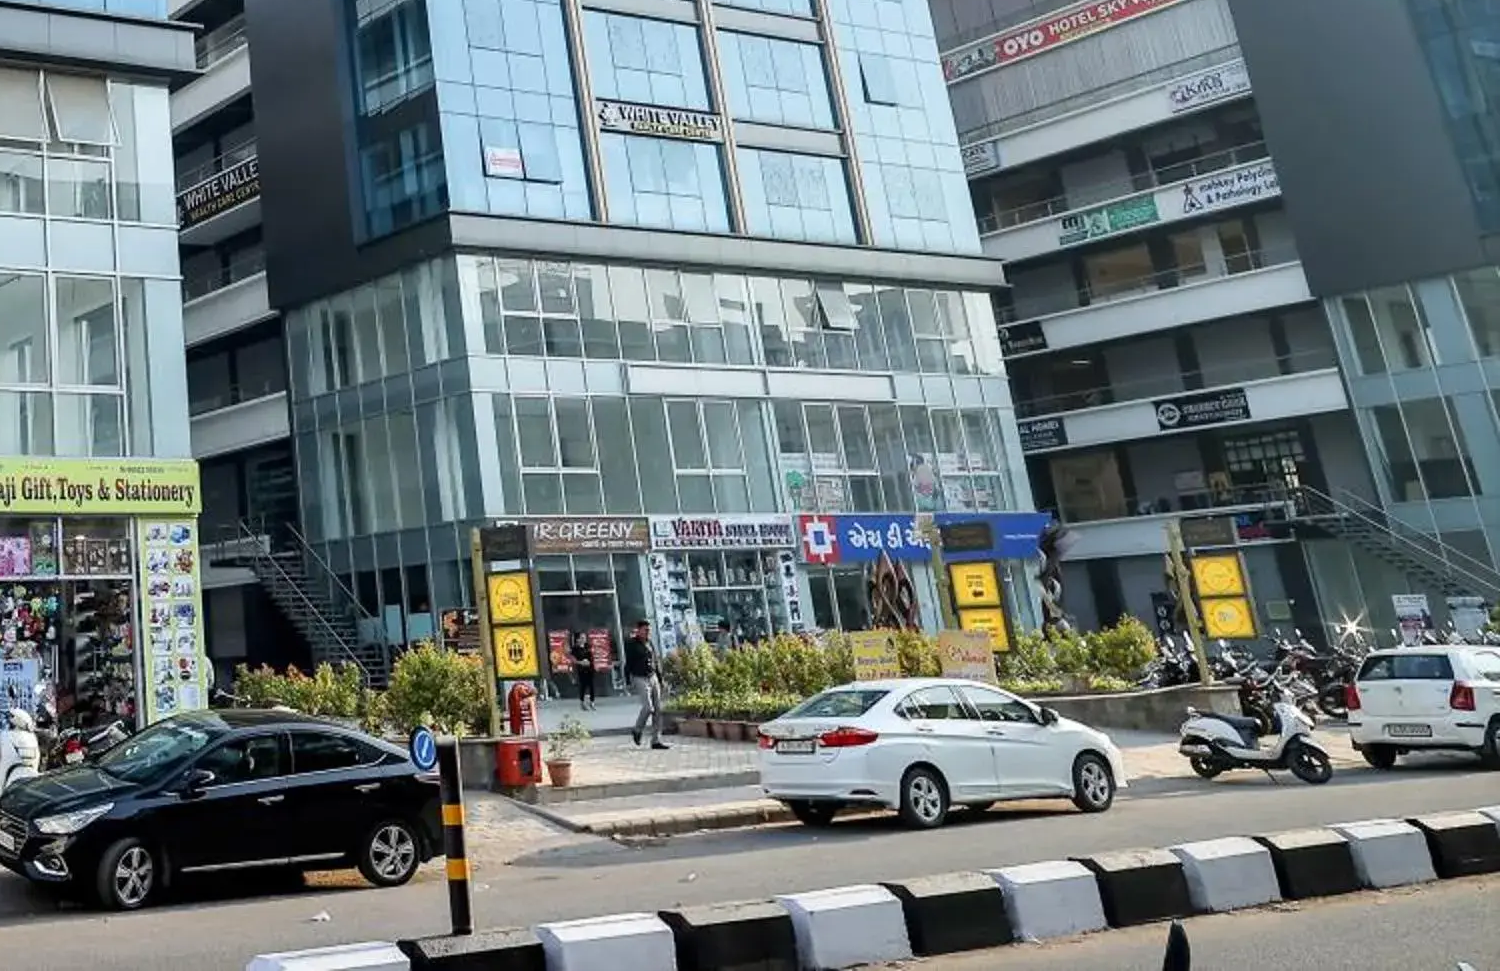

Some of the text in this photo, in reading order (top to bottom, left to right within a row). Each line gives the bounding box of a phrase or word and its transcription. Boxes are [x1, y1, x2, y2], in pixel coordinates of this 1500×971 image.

[1003, 30, 1044, 55] OYO
[1049, 11, 1097, 37] HOTEL
[619, 105, 668, 126] WHITE
[668, 110, 722, 130] VALLEY
[184, 180, 220, 210] WHITE
[221, 159, 259, 191] VALLE
[98, 478, 111, 501] &
[115, 478, 194, 508] Stationery
[559, 521, 635, 541] GREENY
